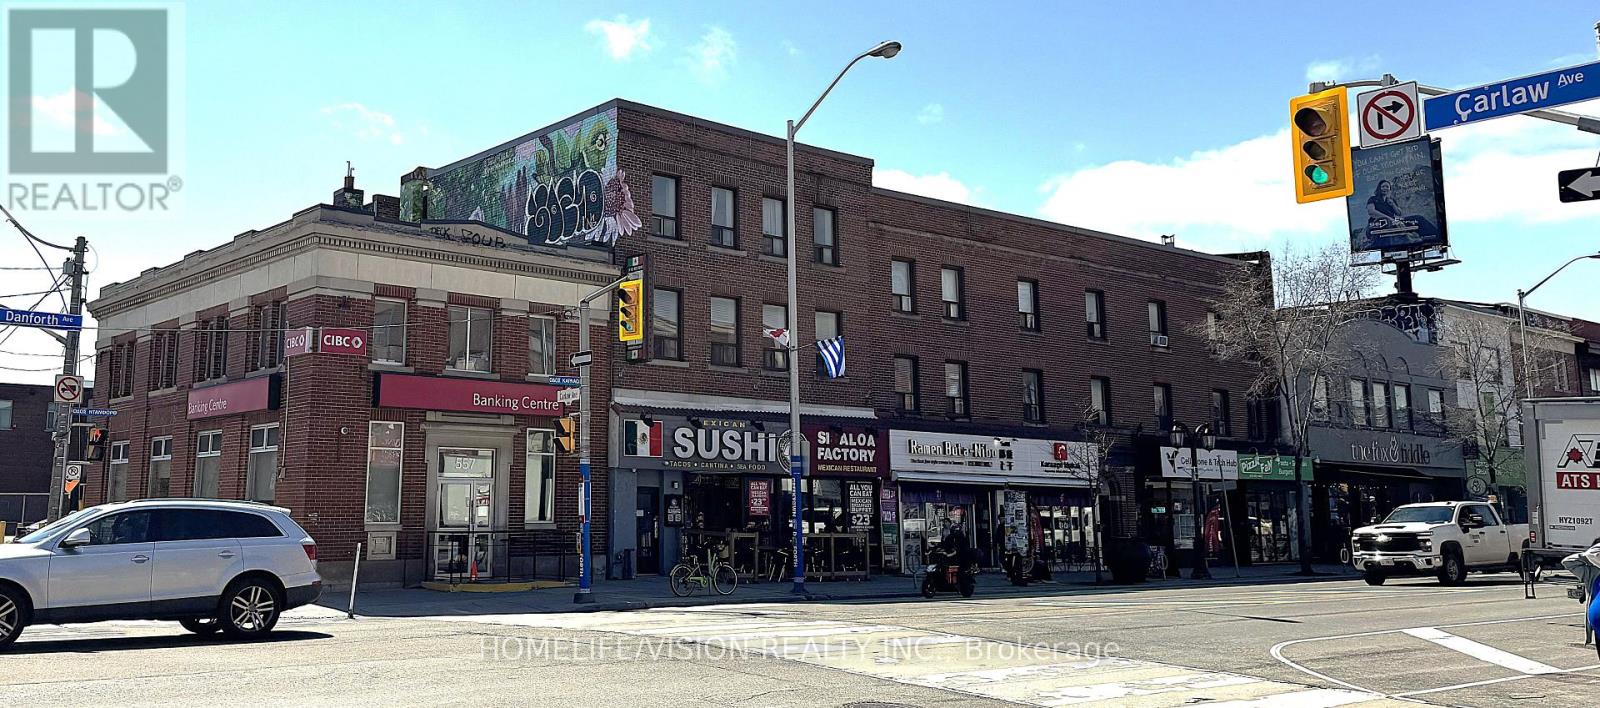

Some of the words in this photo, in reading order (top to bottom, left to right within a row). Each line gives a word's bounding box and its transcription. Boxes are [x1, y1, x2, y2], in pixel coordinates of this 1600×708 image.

[1454, 81, 1549, 116] Carlaw
[1558, 71, 1584, 86] Ave
[5, 311, 58, 325] Danforth
[286, 336, 298, 349] CIBC
[323, 334, 350, 347] CIBC
[188, 401, 208, 415] Banking
[209, 398, 227, 411] Centre
[473, 393, 518, 410] Banking
[522, 396, 559, 410] Centre
[703, 420, 746, 428] EXICAN
[674, 427, 775, 461] SUSHI
[817, 431, 875, 447] SIALOA
[909, 439, 942, 455] Ramen
[817, 447, 875, 462] FACTORY
[455, 458, 476, 470] 557
[670, 460, 691, 468] TACOS
[1227, 459, 1237, 467] Hub
[1561, 474, 1591, 488] ATS
